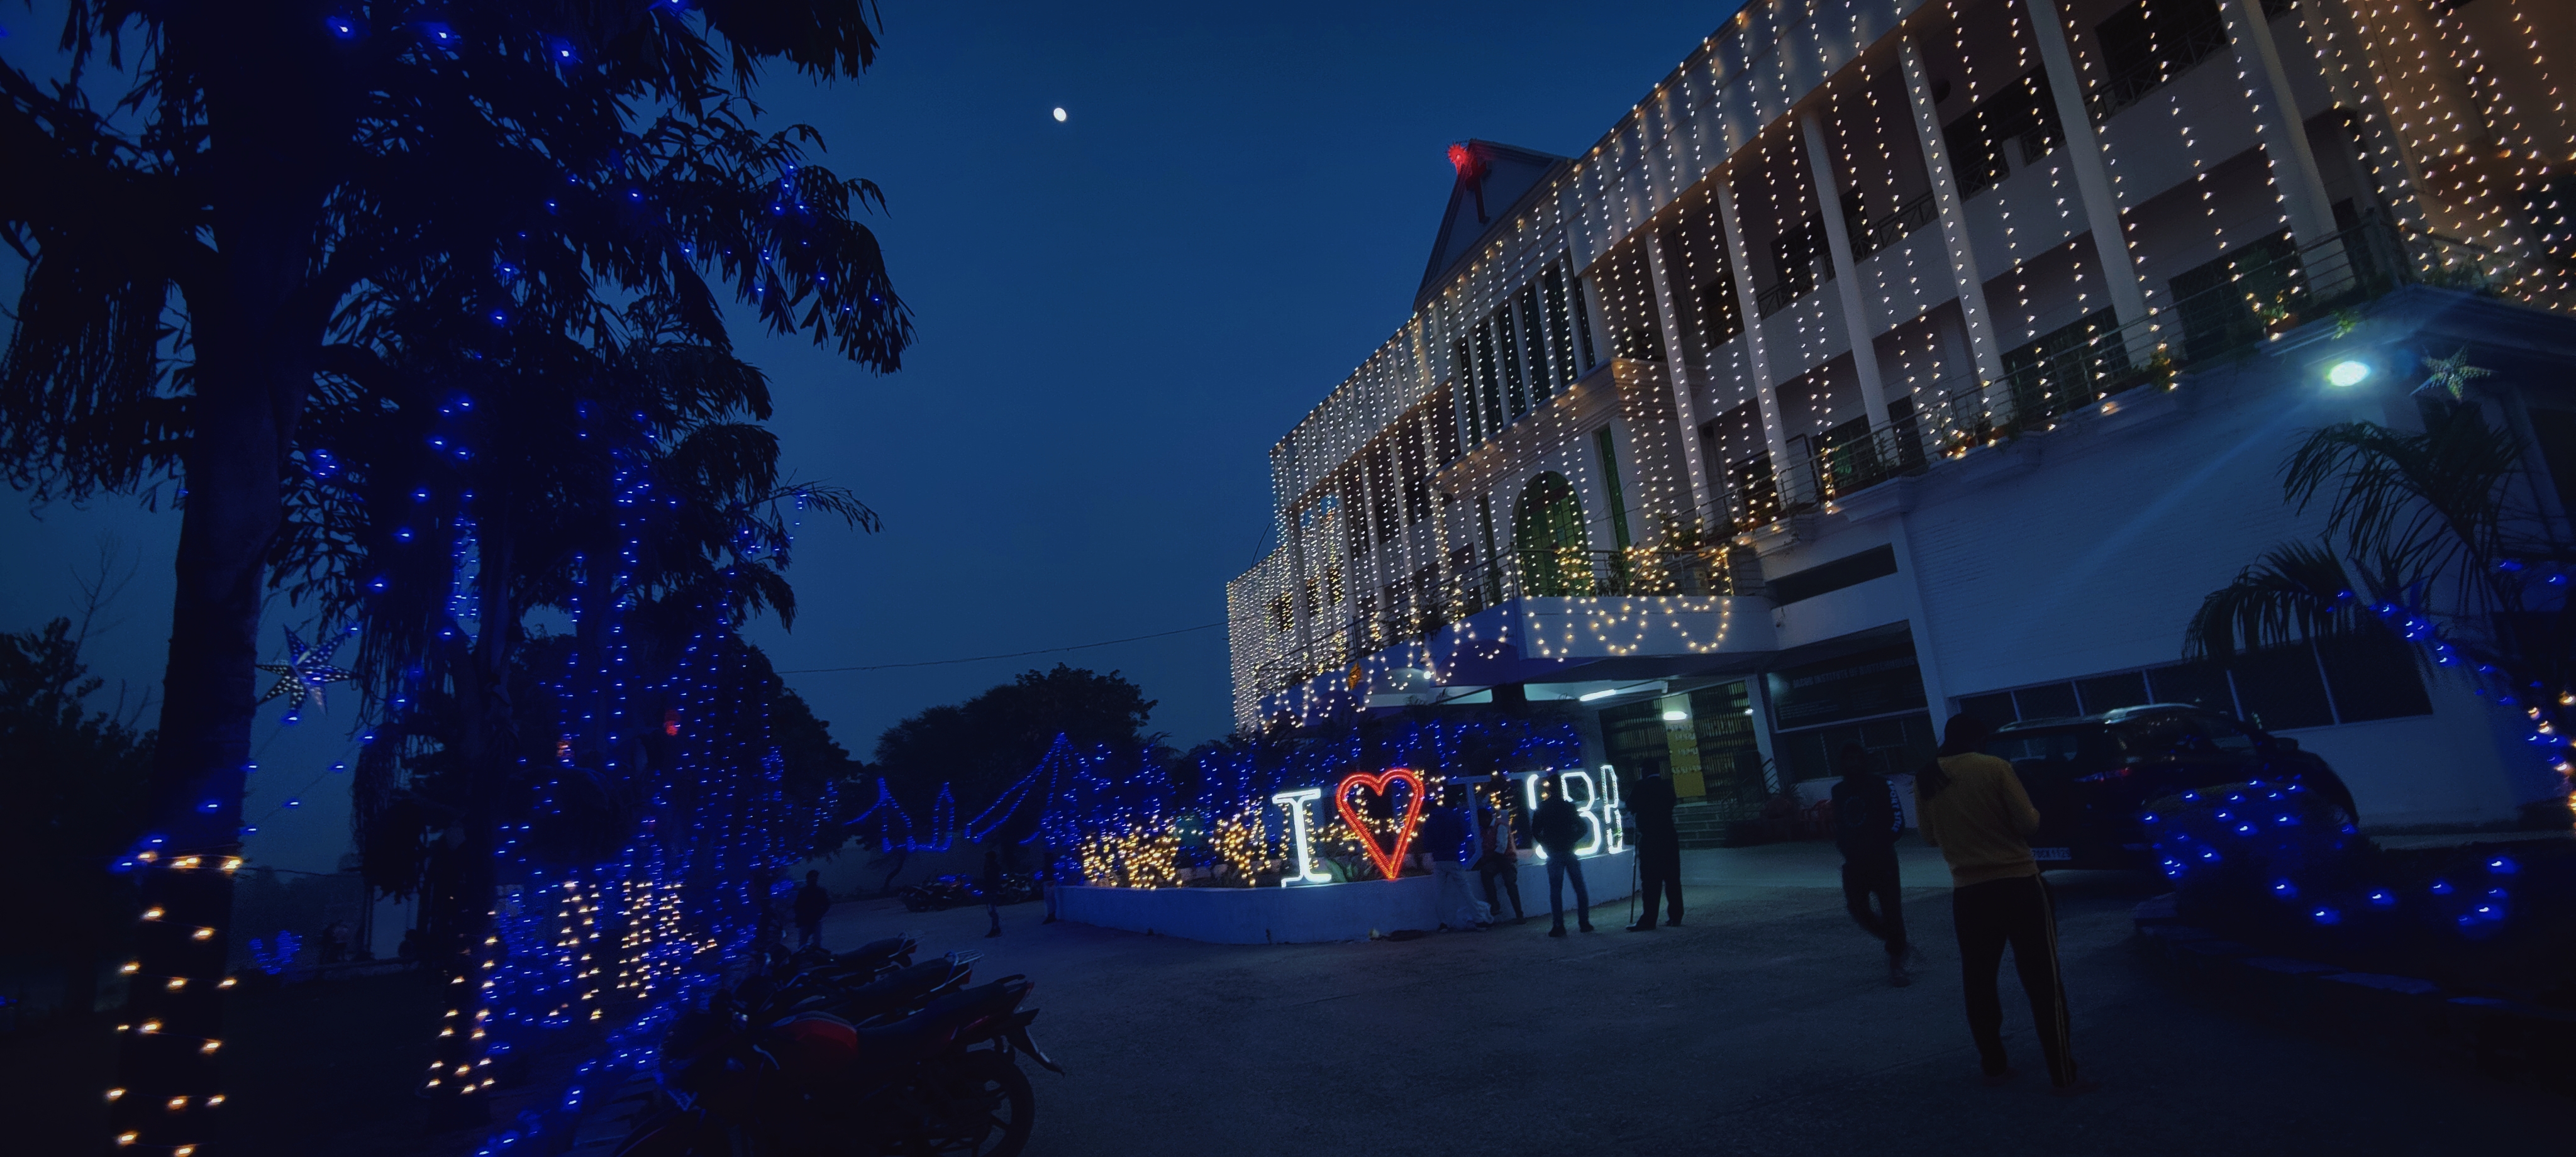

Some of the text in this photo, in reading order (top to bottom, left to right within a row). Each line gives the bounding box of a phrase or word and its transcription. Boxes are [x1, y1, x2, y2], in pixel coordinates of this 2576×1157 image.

[1814, 668, 1849, 684] INSTITUTE
[1849, 667, 1858, 677] OF
[1859, 656, 1918, 675] BIOTECHNOLOG
